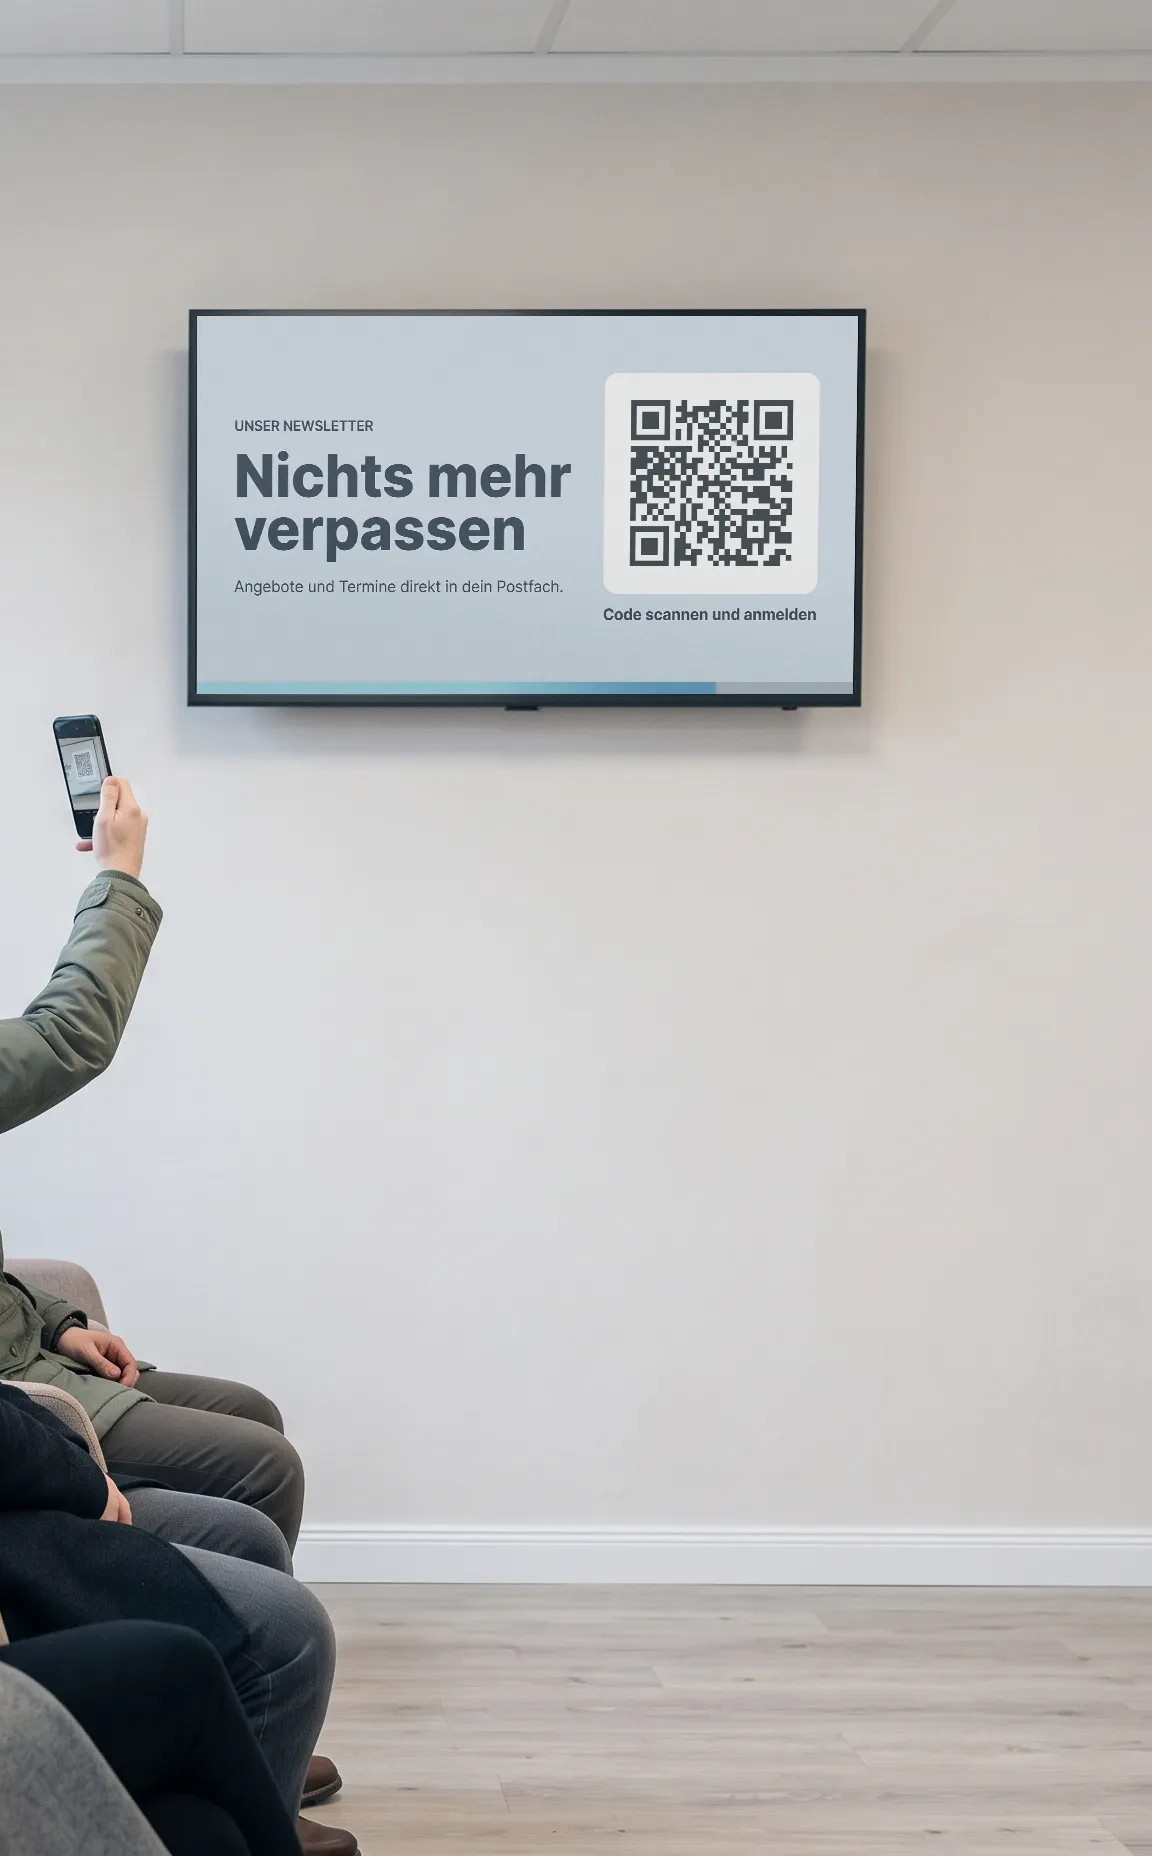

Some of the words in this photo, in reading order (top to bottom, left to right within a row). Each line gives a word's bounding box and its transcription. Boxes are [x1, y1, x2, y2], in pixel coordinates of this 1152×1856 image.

[235, 420, 279, 431] UNSER
[284, 420, 373, 431] NEWSLETTER
[236, 451, 414, 498] Nichts
[429, 454, 571, 498] mehr
[235, 517, 524, 562] verpassen
[234, 580, 303, 596] Angebote
[309, 580, 334, 592] und
[339, 580, 395, 592] Termine
[401, 580, 441, 592] direkt
[446, 580, 457, 592] in
[462, 580, 492, 592] dein
[498, 580, 563, 592] Postfach.
[604, 608, 641, 620] Code
[646, 610, 708, 620] scannen
[713, 608, 740, 620] und
[744, 608, 816, 620] anmelden
